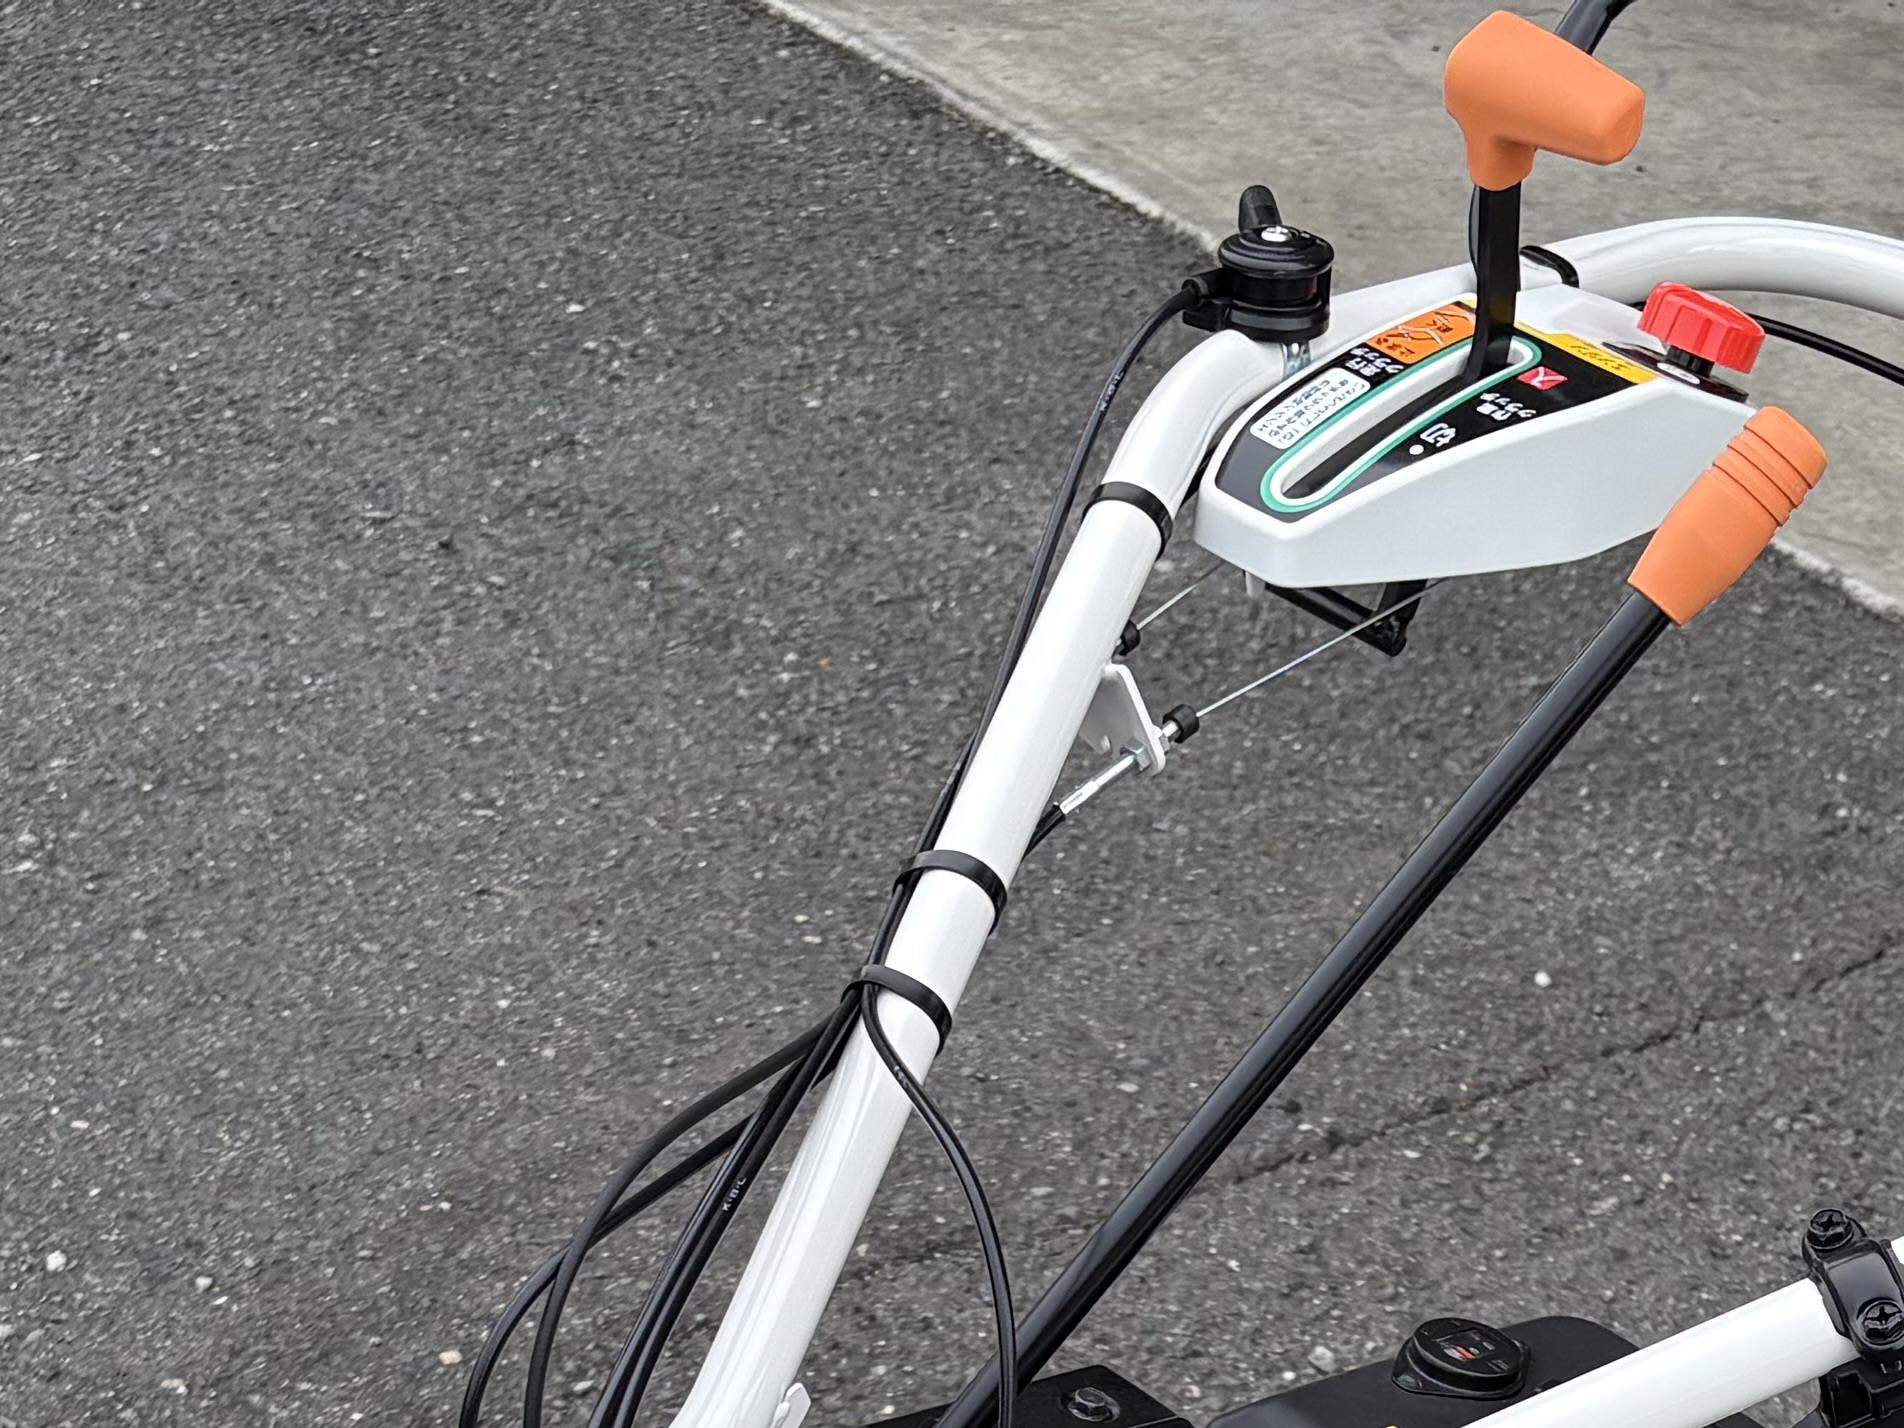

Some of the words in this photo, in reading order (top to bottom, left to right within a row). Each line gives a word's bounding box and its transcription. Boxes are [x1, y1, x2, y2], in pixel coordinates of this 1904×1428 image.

[1350, 347, 1405, 374] クラッチ
[1530, 366, 1569, 388] 入
[1480, 392, 1537, 418] クラッチ
[1420, 422, 1457, 448] 切
